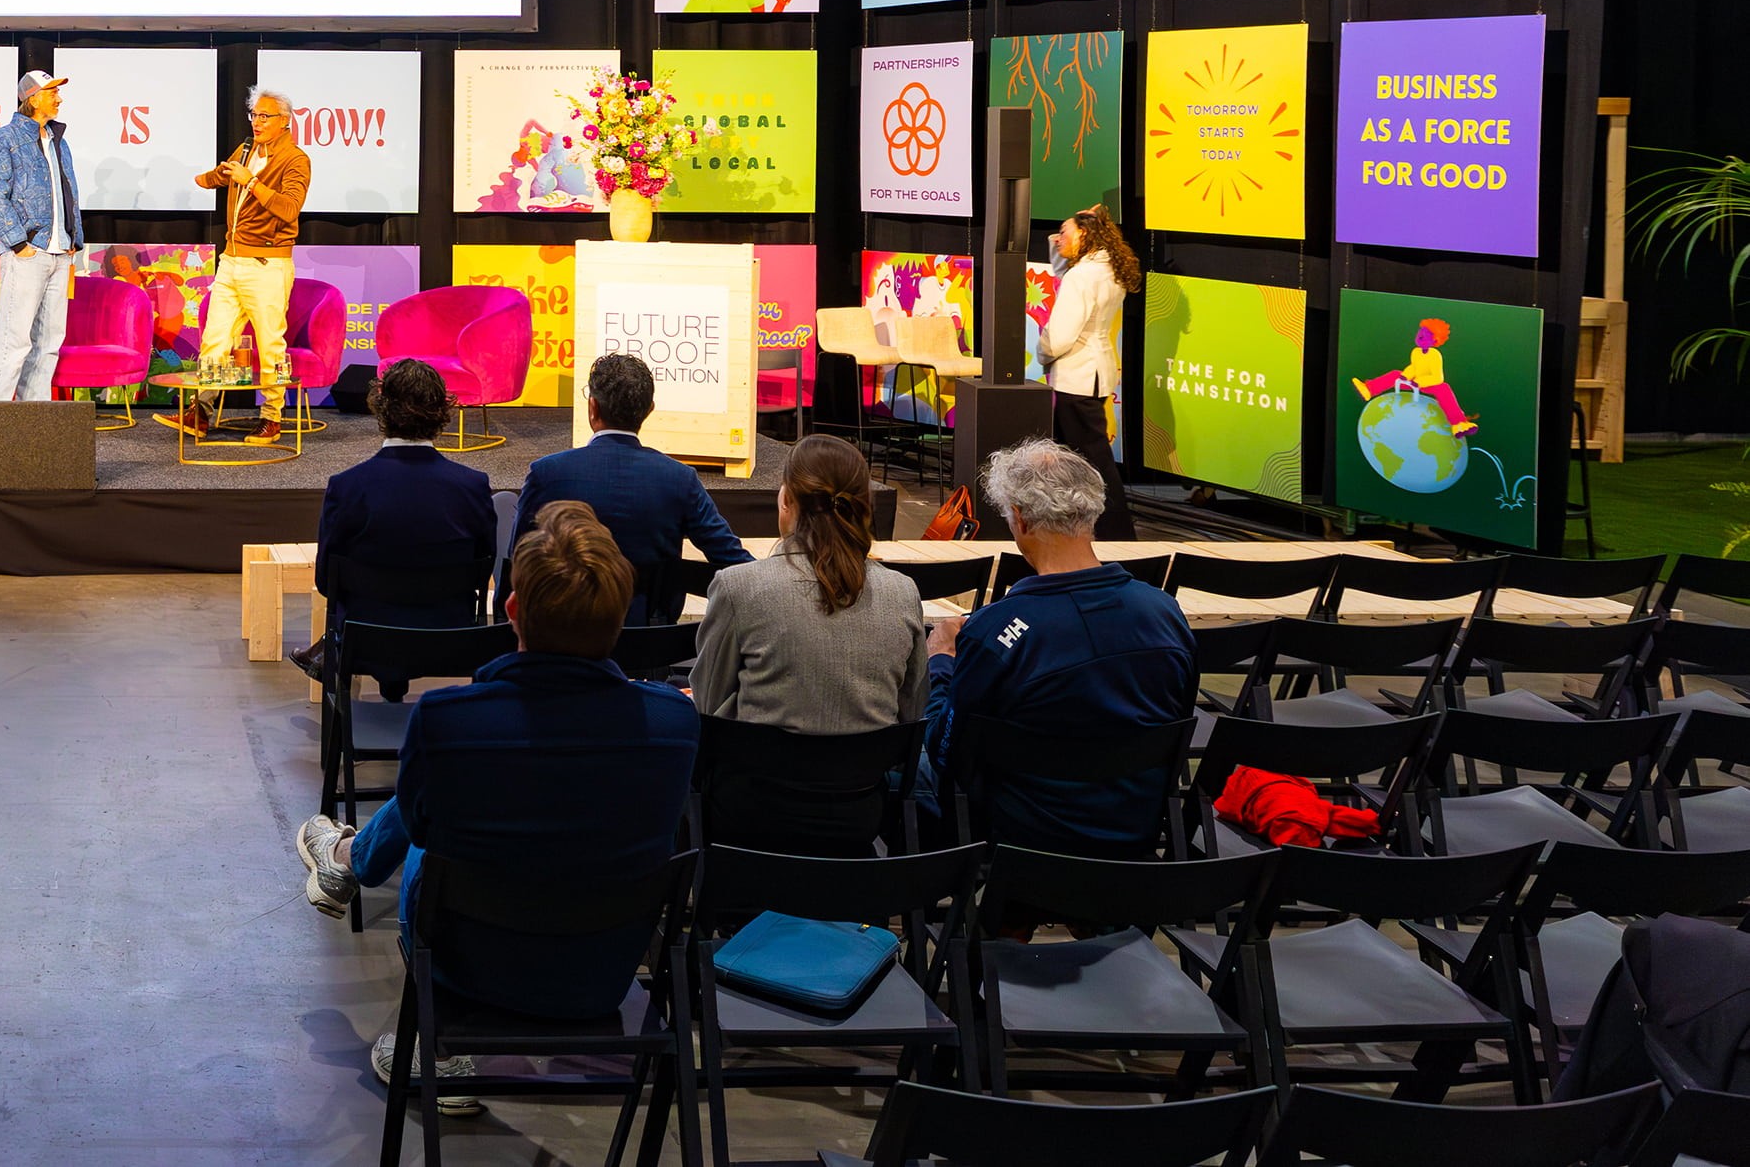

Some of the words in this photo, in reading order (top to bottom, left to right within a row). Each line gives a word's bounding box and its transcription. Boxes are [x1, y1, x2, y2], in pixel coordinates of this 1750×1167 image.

[873, 57, 960, 71] PARTNERSHIPS
[1377, 74, 1498, 100] BUSINESS
[1186, 104, 1259, 116] TOMORROW
[120, 106, 150, 145] IS
[1199, 127, 1244, 138] STARTS
[1361, 118, 1391, 143] AS
[1398, 118, 1416, 143] A
[1425, 119, 1511, 145] FORCE
[692, 157, 776, 170] LOCAL
[1201, 149, 1242, 160] TODAY
[1362, 160, 1413, 186] FOR
[1420, 163, 1507, 190] GOOD
[870, 189, 892, 199] FOR
[895, 189, 918, 200] THE
[921, 191, 960, 202] GOALS
[605, 313, 720, 339] FUTURE
[605, 338, 719, 364] PROOF
[650, 367, 719, 383] ENTION
[1166, 358, 1213, 379] TIME
[1226, 368, 1266, 389] FOR
[1155, 374, 1288, 412] TRANSITION
[997, 617, 1030, 649] HH
